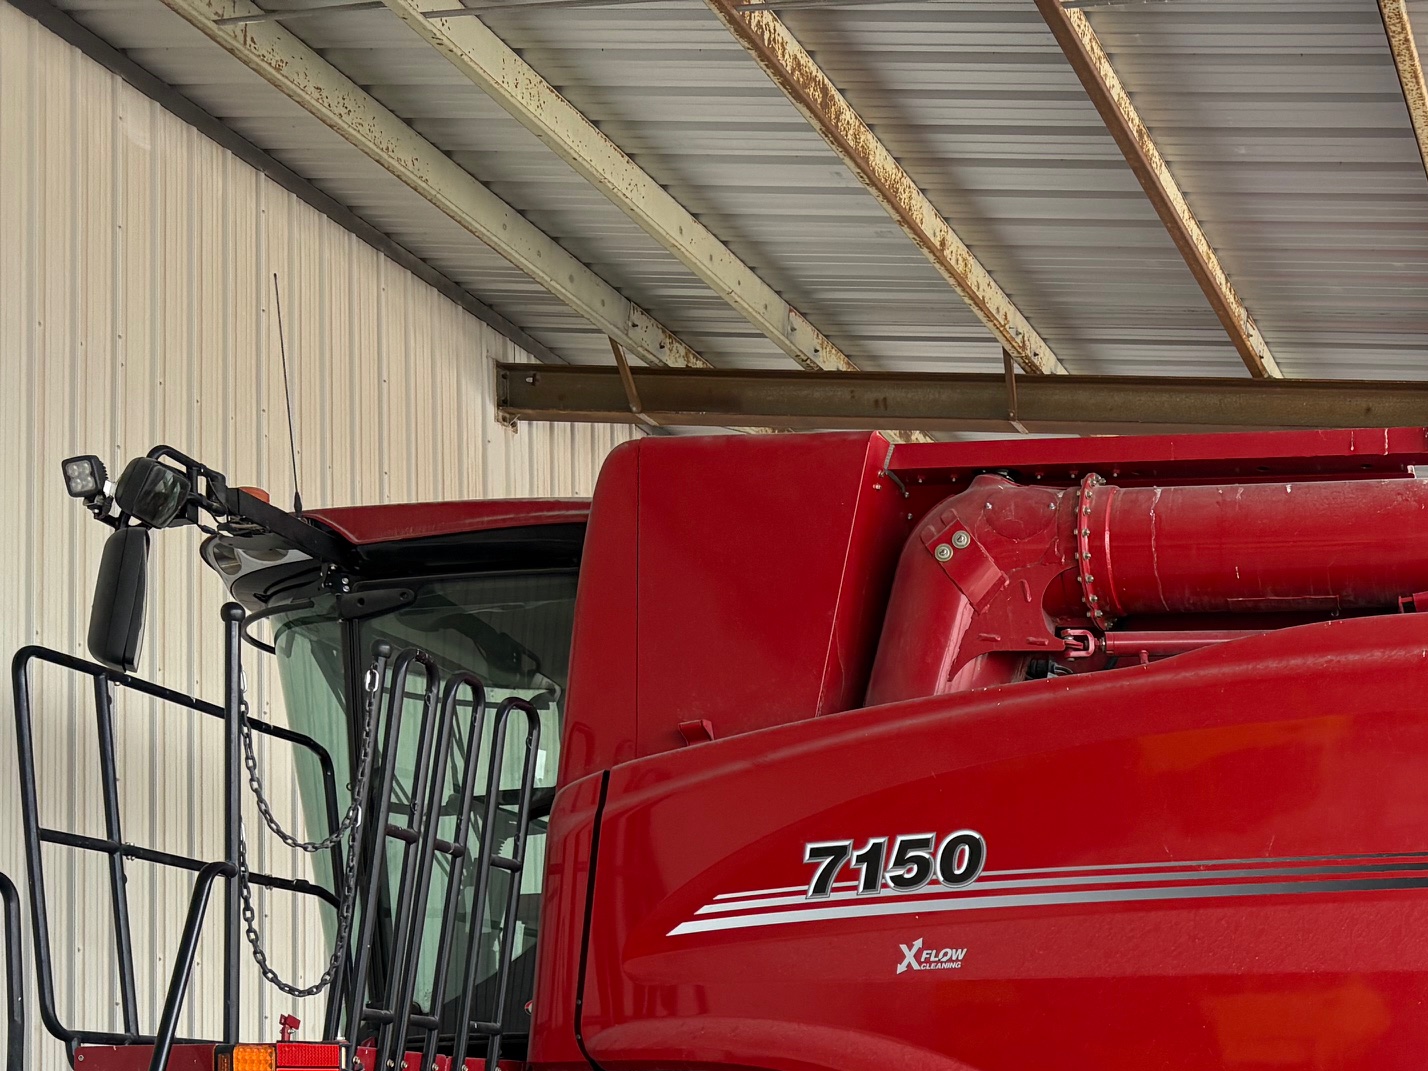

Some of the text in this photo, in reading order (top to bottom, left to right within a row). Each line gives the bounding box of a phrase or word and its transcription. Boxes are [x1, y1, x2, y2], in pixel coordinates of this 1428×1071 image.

[803, 828, 987, 900] 7150
[921, 948, 967, 962] FLOW
[920, 961, 962, 970] CLEANING
